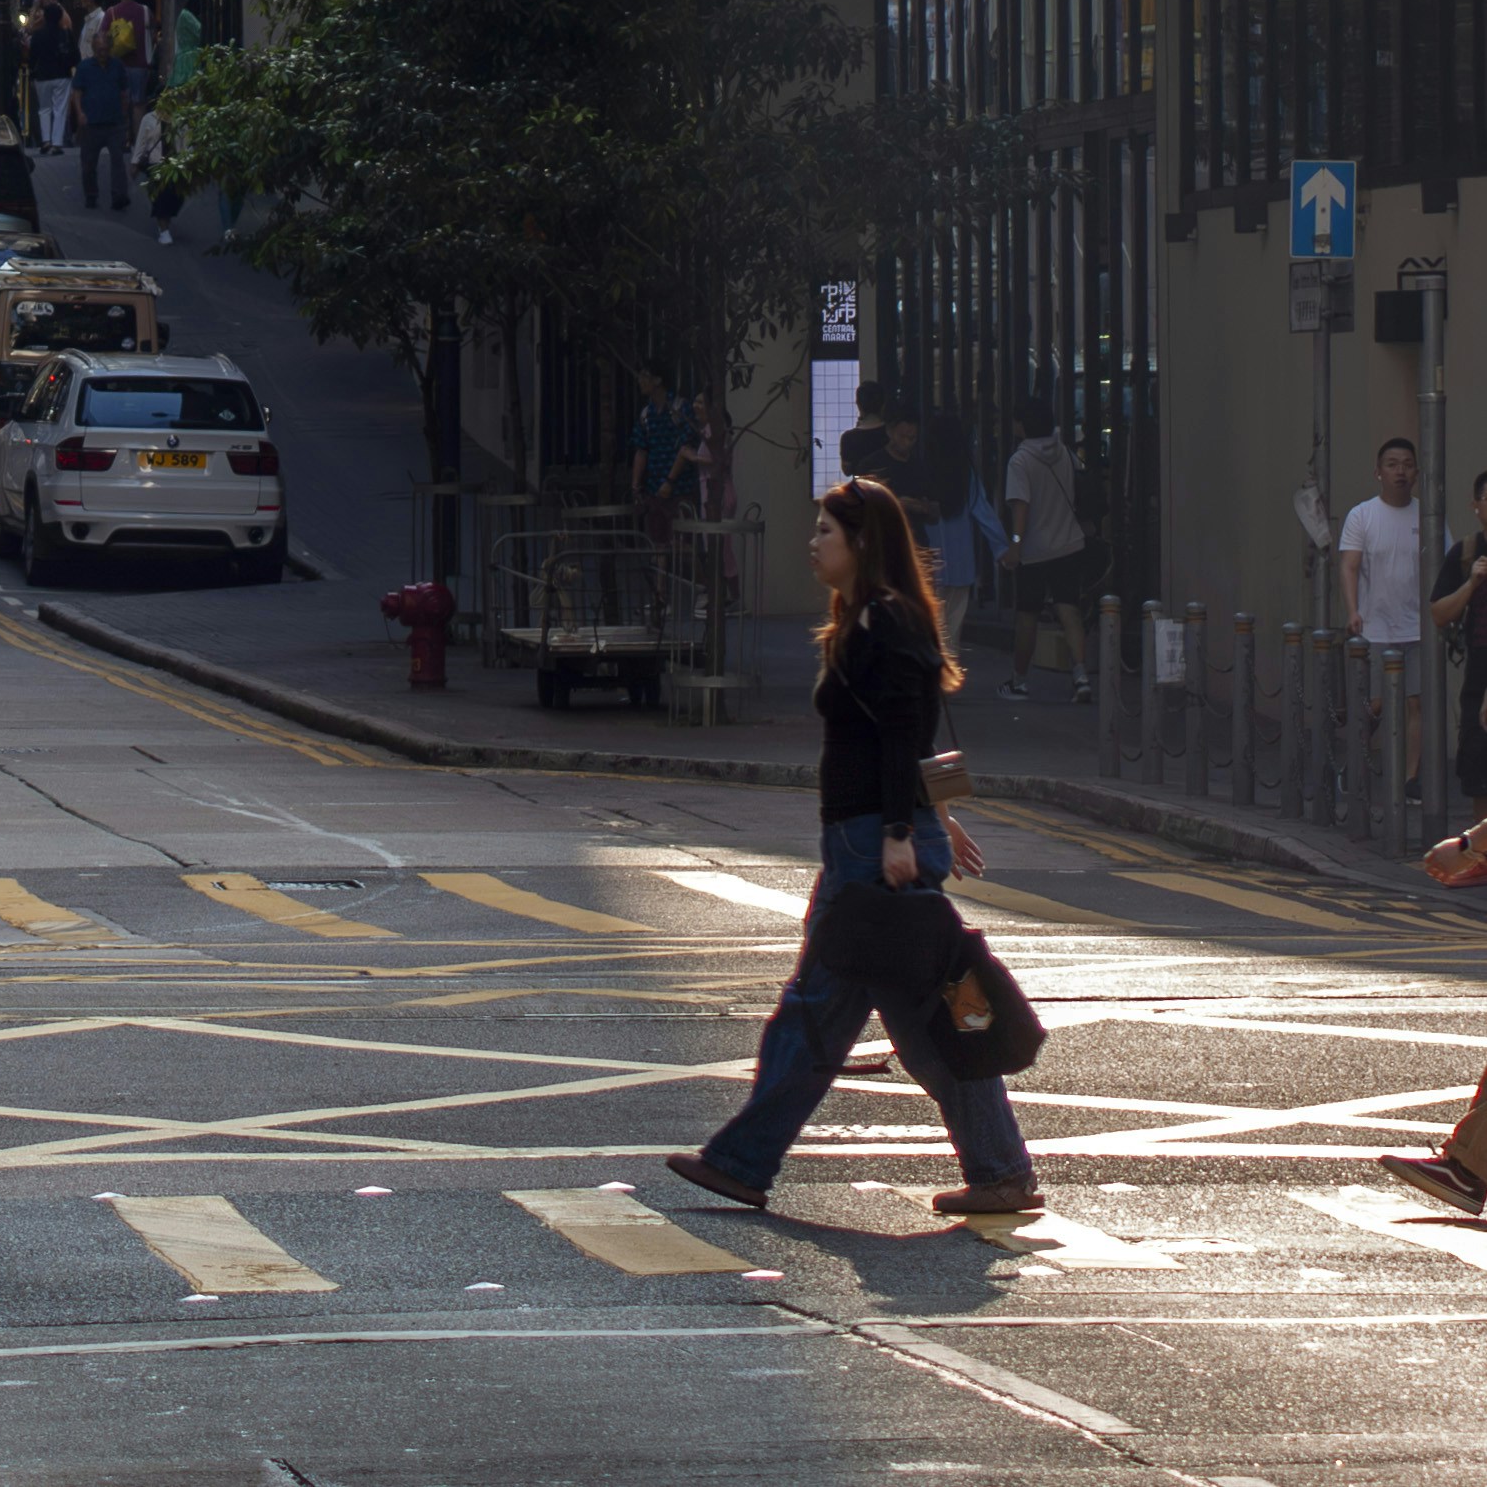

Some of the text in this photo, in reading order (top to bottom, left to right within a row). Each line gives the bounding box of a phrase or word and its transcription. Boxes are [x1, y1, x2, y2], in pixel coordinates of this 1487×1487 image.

[822, 324, 856, 333] CENTRAL
[822, 333, 856, 342] MARKET
[146, 453, 199, 467] WJ 589
